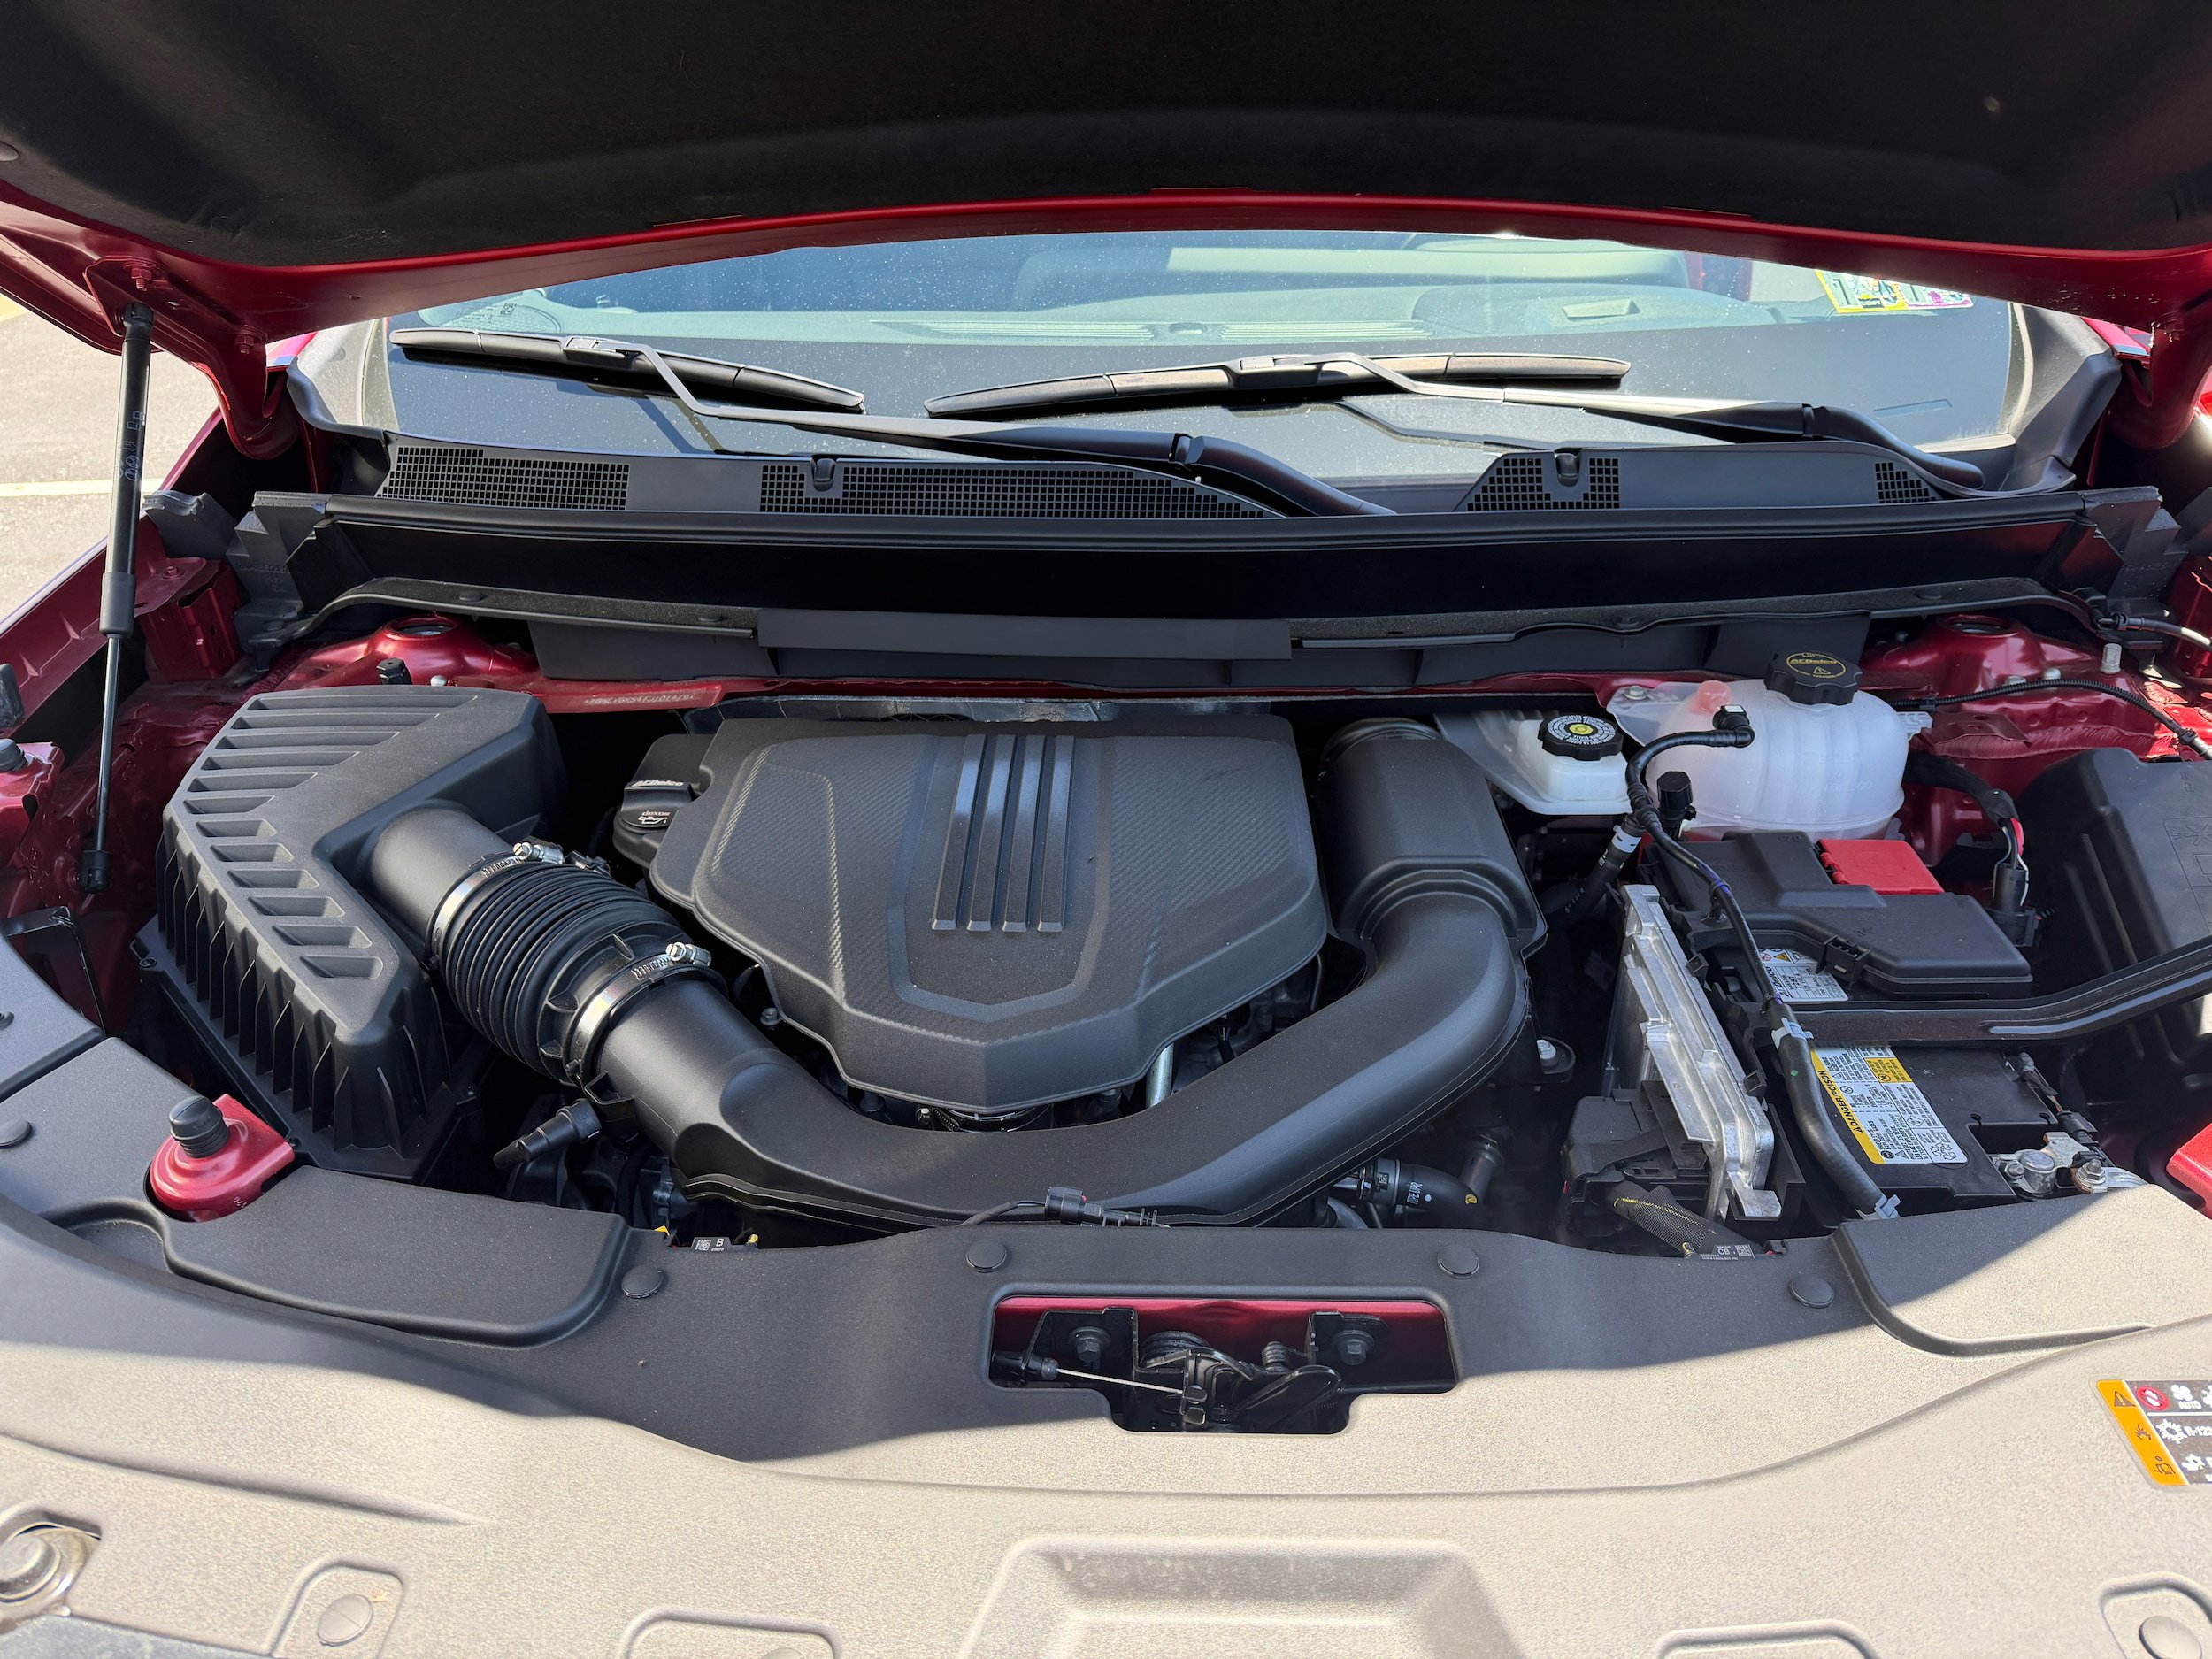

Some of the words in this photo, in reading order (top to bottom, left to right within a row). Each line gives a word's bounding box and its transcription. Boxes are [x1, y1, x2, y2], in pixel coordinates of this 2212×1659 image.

[1817, 1070, 1860, 1128] DANGER/POISON
[716, 1238, 725, 1247] B
[2177, 1400, 2202, 1409] AUTO
